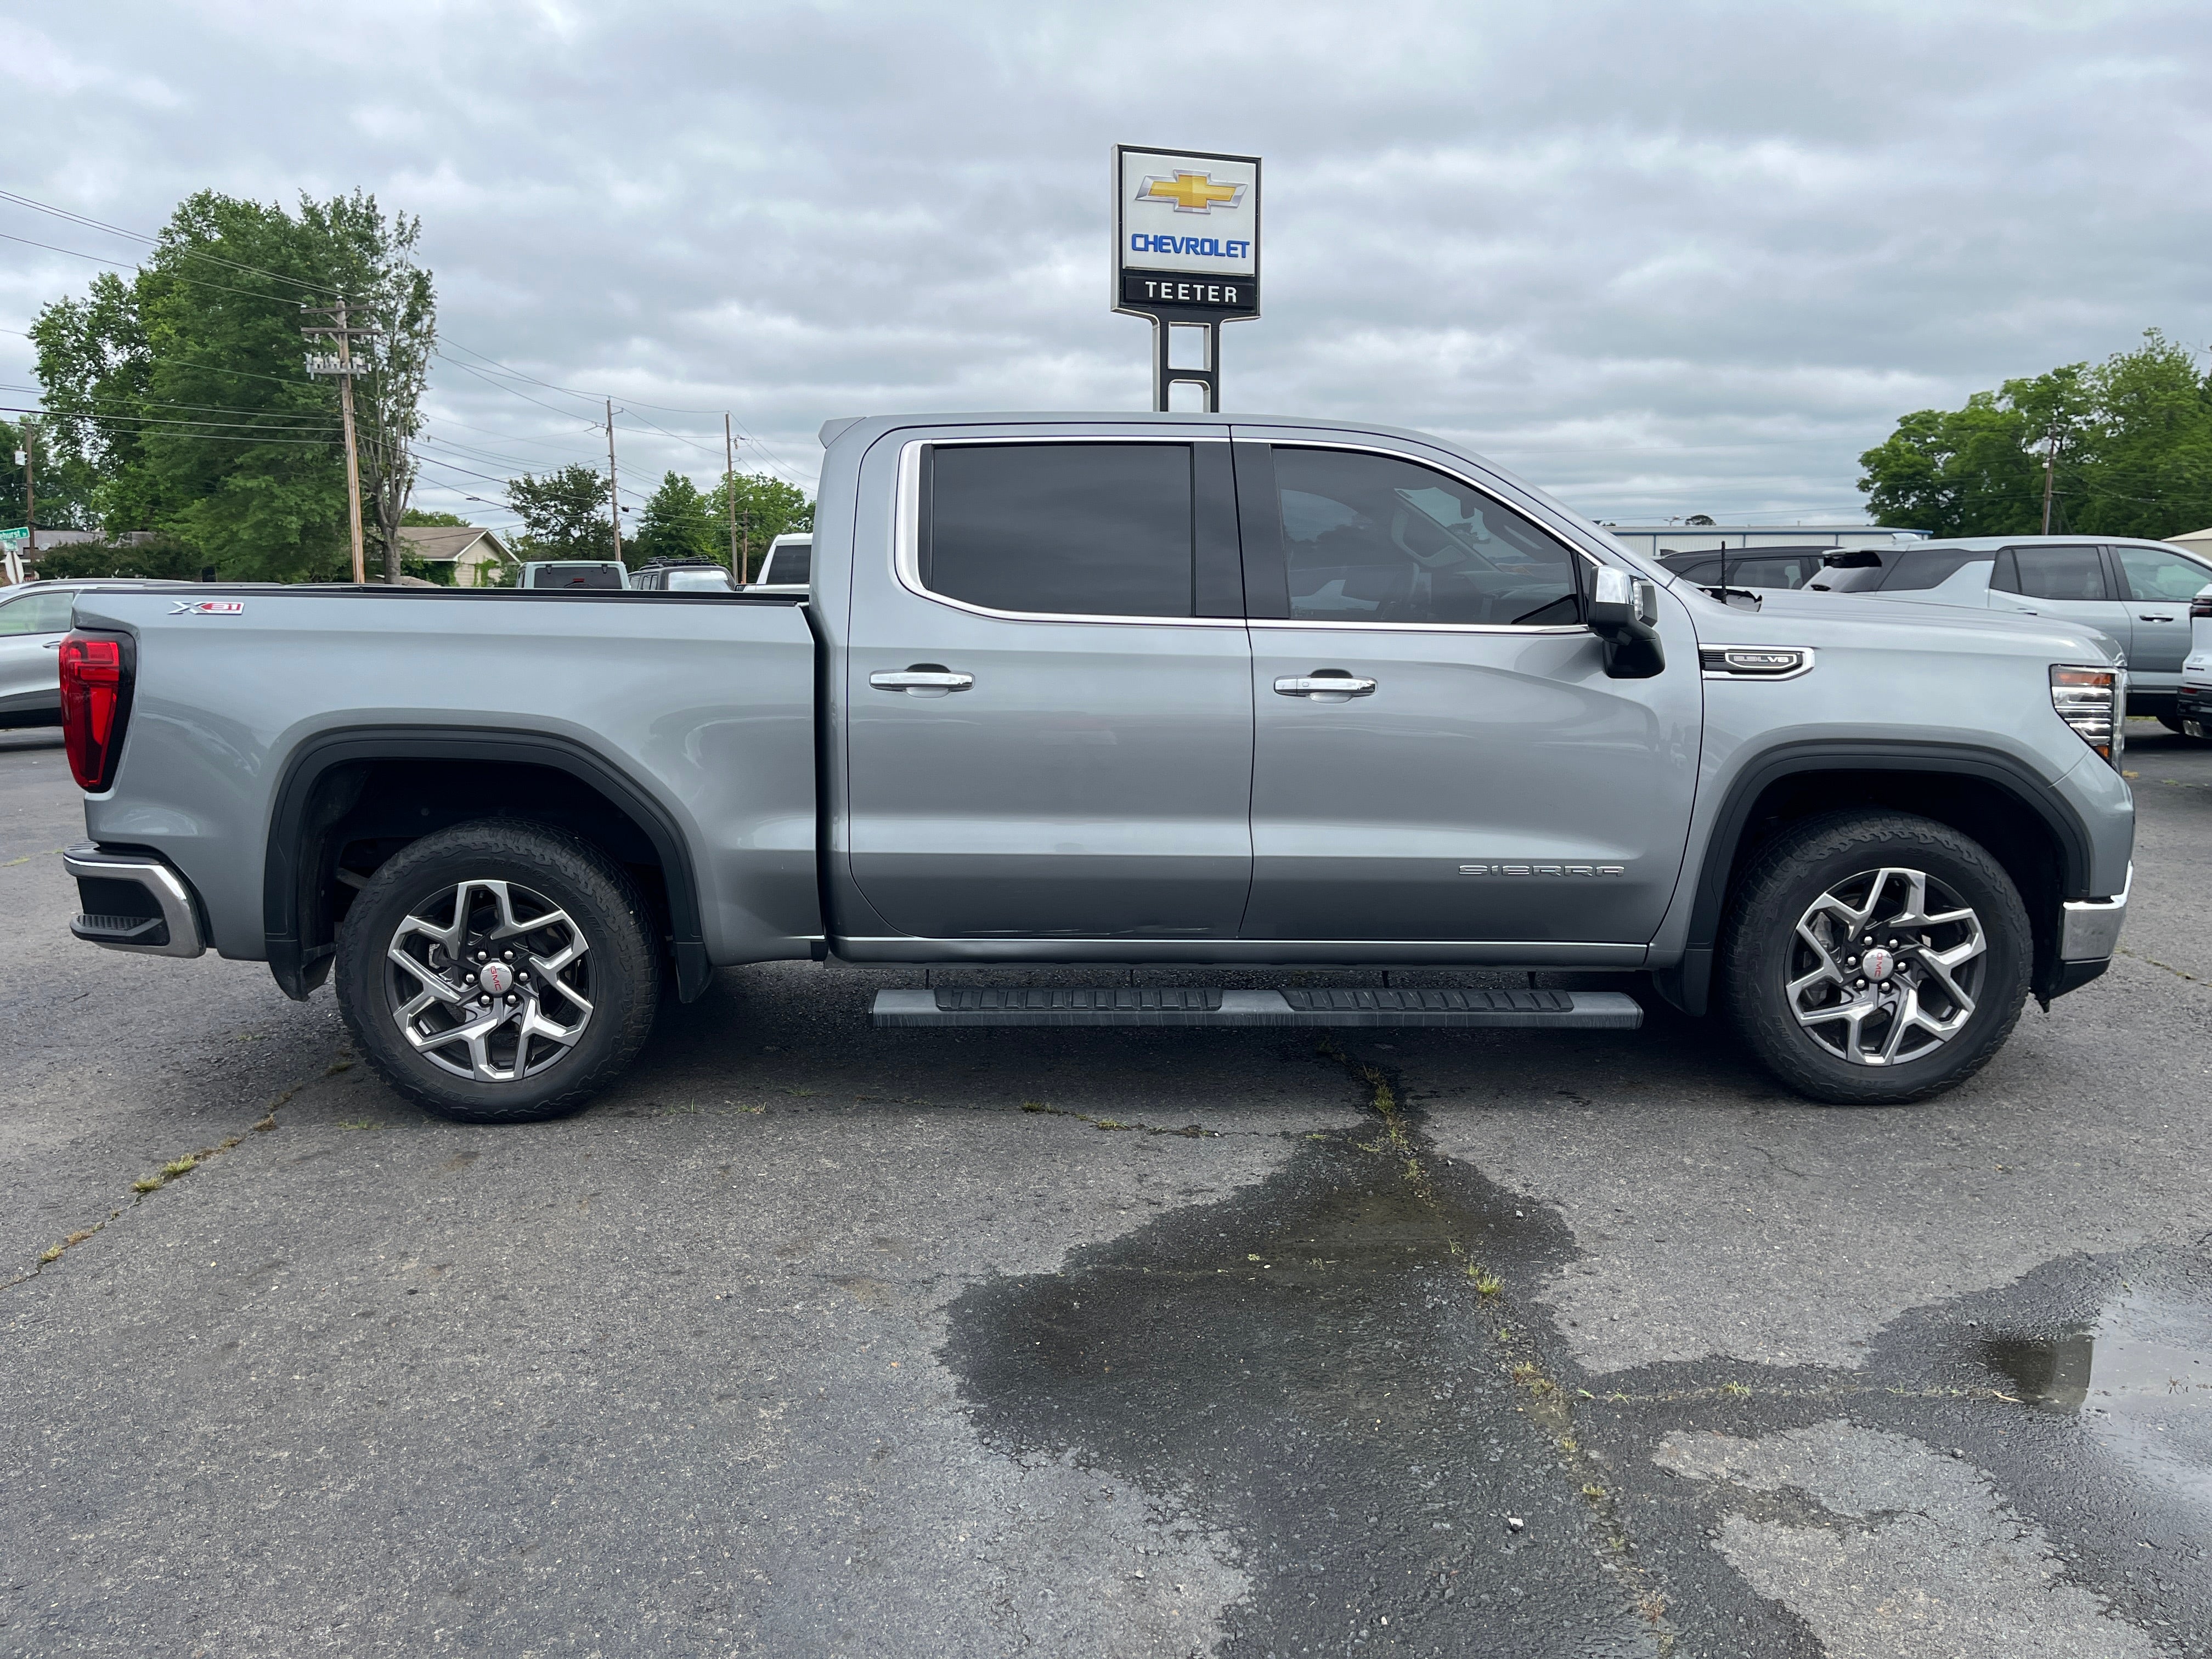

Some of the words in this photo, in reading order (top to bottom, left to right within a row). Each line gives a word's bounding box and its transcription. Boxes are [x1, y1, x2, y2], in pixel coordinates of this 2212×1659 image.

[1132, 234, 1250, 258] CHEVROLET
[1145, 281, 1237, 303] TEETER
[167, 601, 244, 614] X31
[1459, 865, 1624, 876] SIERRA
[1874, 952, 1883, 977] GMC
[490, 966, 502, 991] GMC
